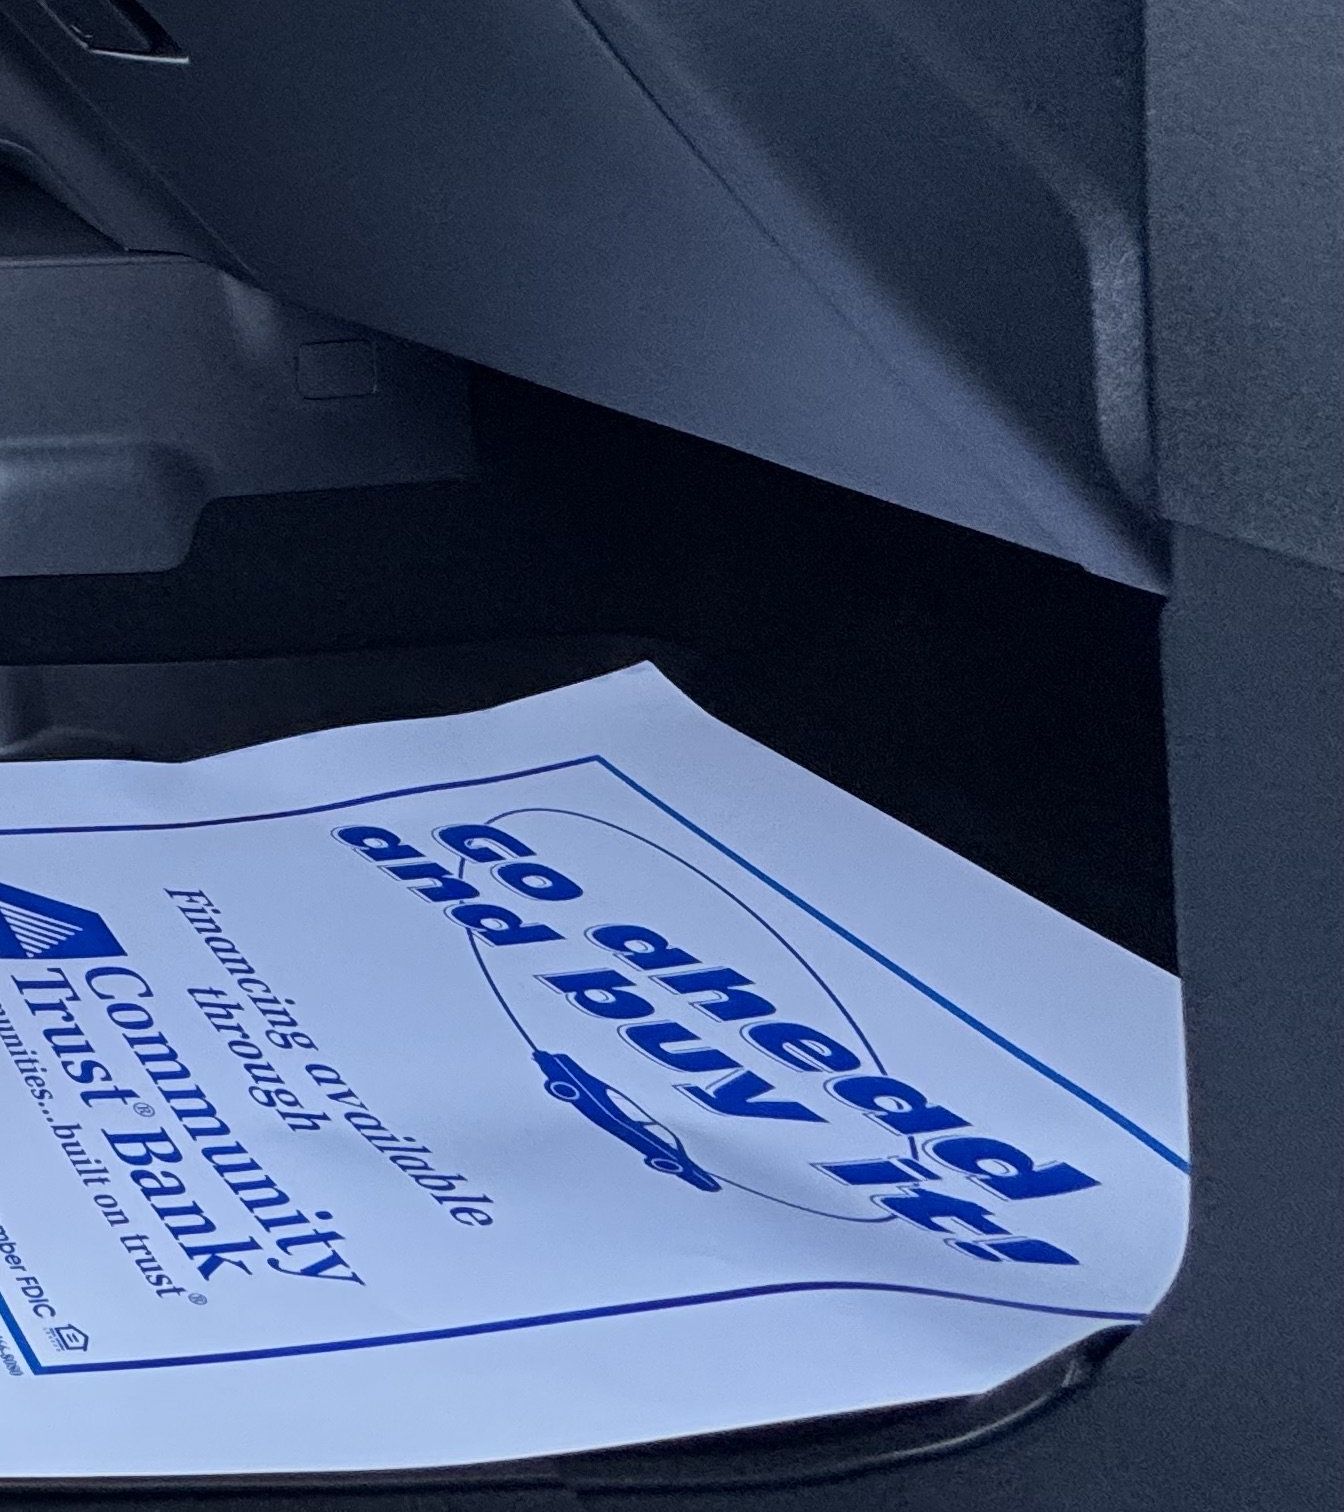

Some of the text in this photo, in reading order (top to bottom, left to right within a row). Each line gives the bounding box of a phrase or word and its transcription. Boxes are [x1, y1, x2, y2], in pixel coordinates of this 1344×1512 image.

[86, 966, 367, 1287] Community
[165, 888, 494, 1227] Financing available
[187, 986, 331, 1133] through
[330, 824, 1081, 1265] and buy it!
[432, 824, 1102, 1201] Go ahead
[16, 1276, 57, 1319] FDIC
[93, 1193, 130, 1228] on
[101, 1126, 263, 1282] Bank
